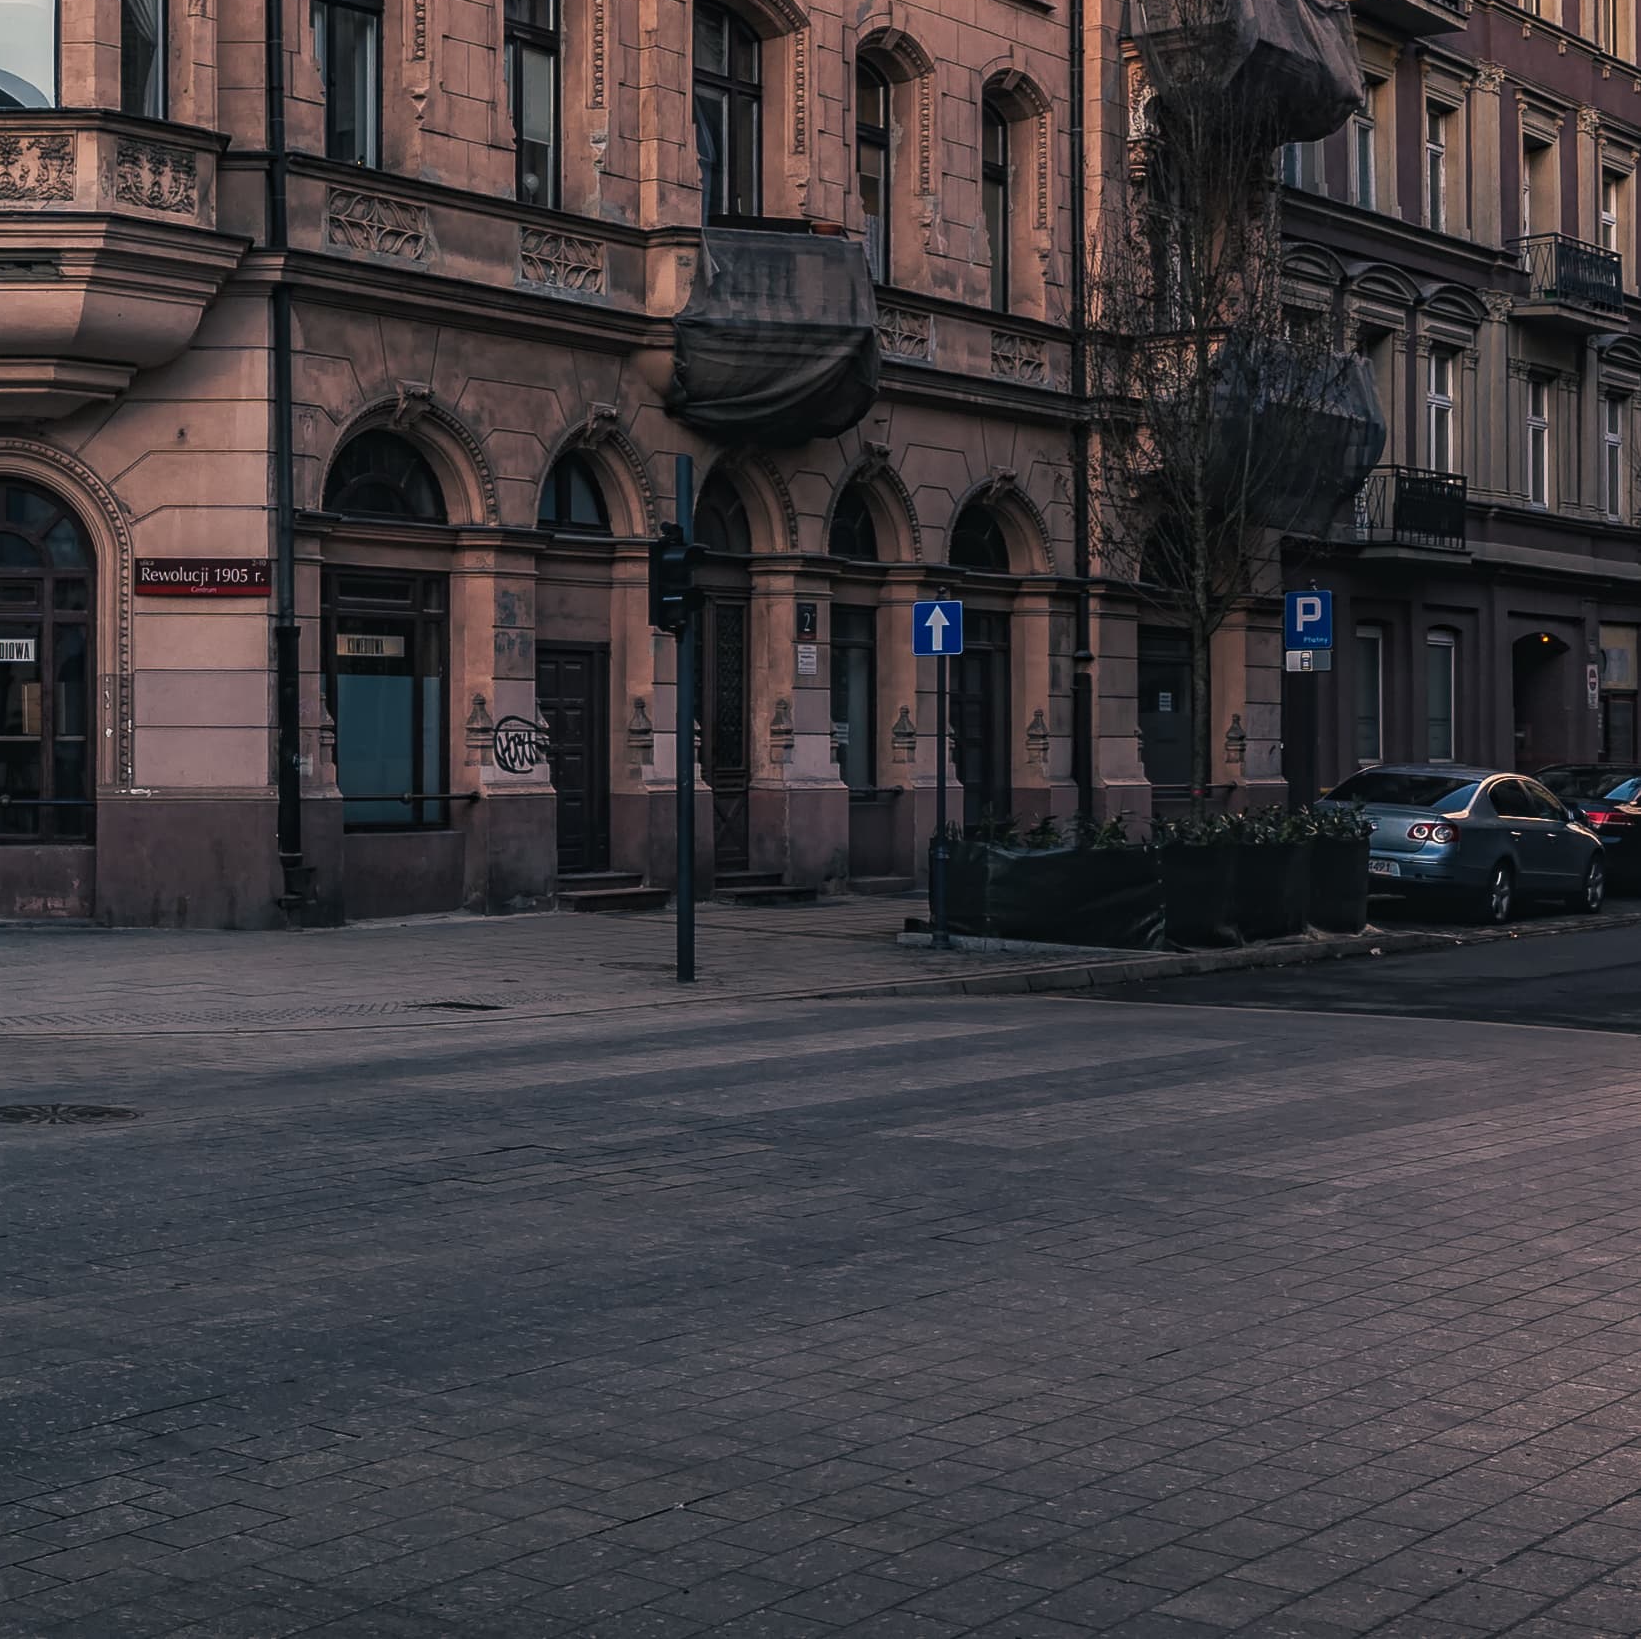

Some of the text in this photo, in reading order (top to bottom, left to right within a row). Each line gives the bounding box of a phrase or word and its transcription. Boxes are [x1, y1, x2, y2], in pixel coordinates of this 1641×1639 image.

[141, 566, 266, 587] Rewolucji 1905 r.
[1296, 596, 1322, 632] P
